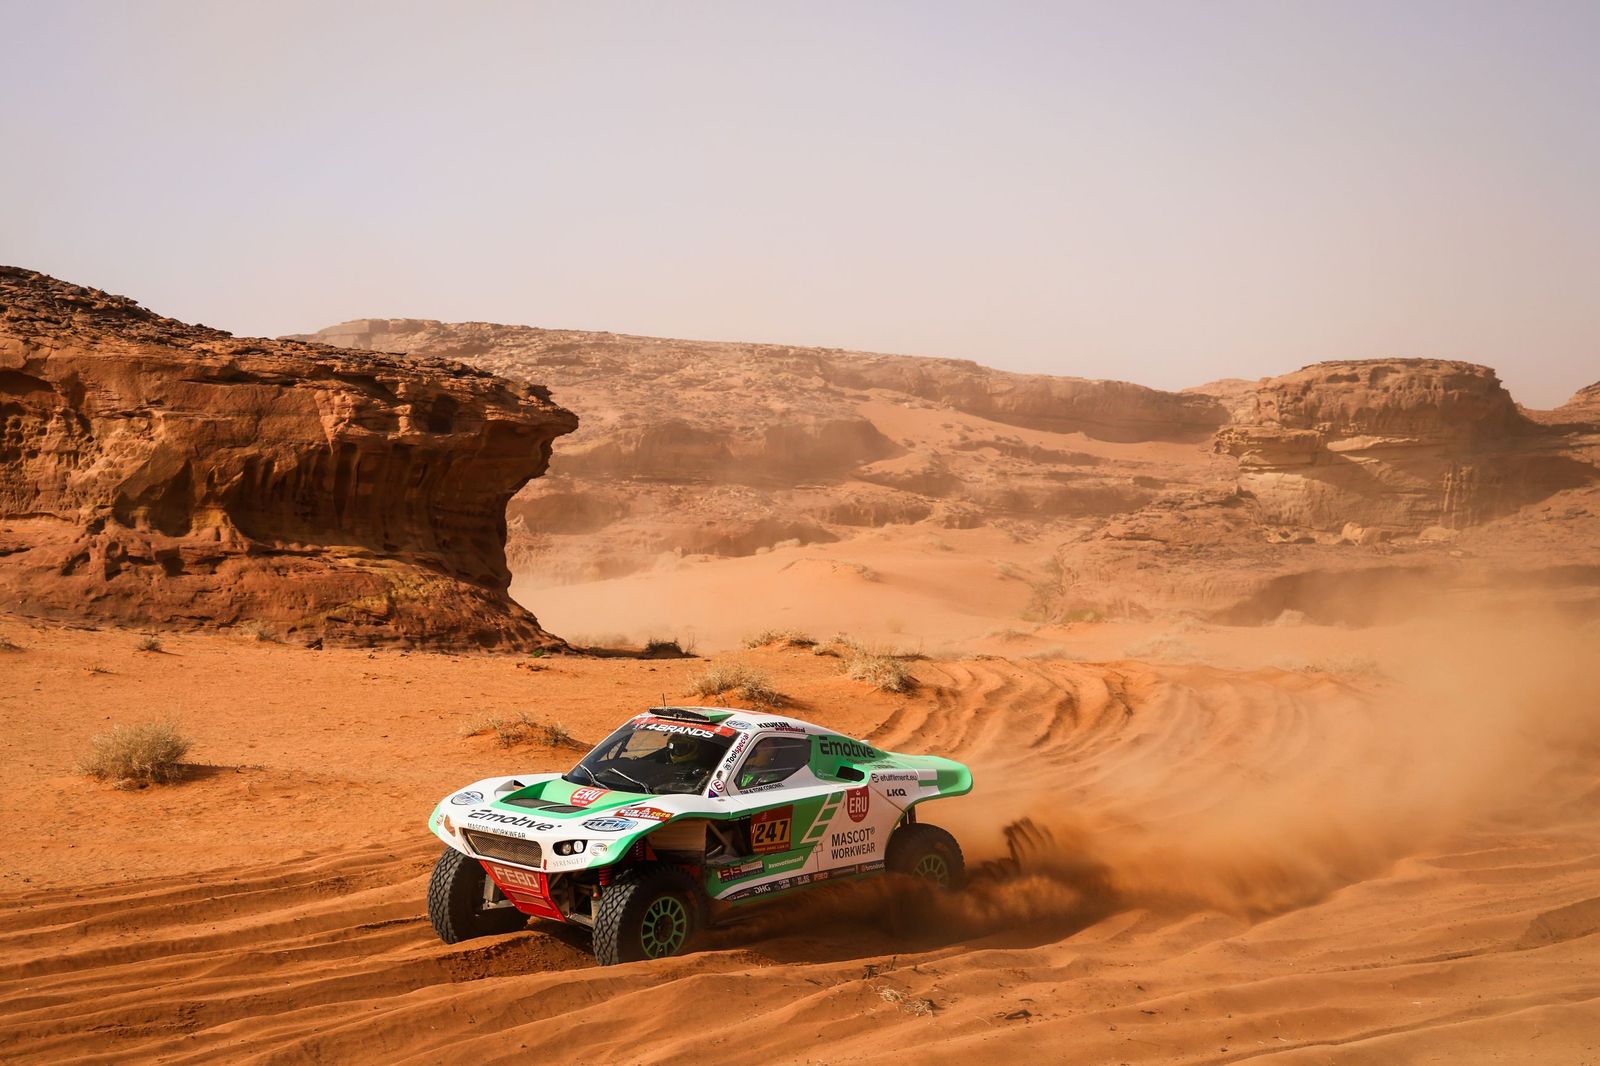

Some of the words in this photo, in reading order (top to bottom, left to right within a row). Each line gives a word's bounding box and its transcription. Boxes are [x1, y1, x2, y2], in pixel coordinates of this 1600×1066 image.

[726, 733, 749, 764] Toolspecial
[819, 735, 875, 758] Emotive
[886, 788, 907, 797] LKQ
[849, 796, 868, 814] ERU
[754, 820, 788, 844] 247
[831, 843, 876, 860] WORKWEAR
